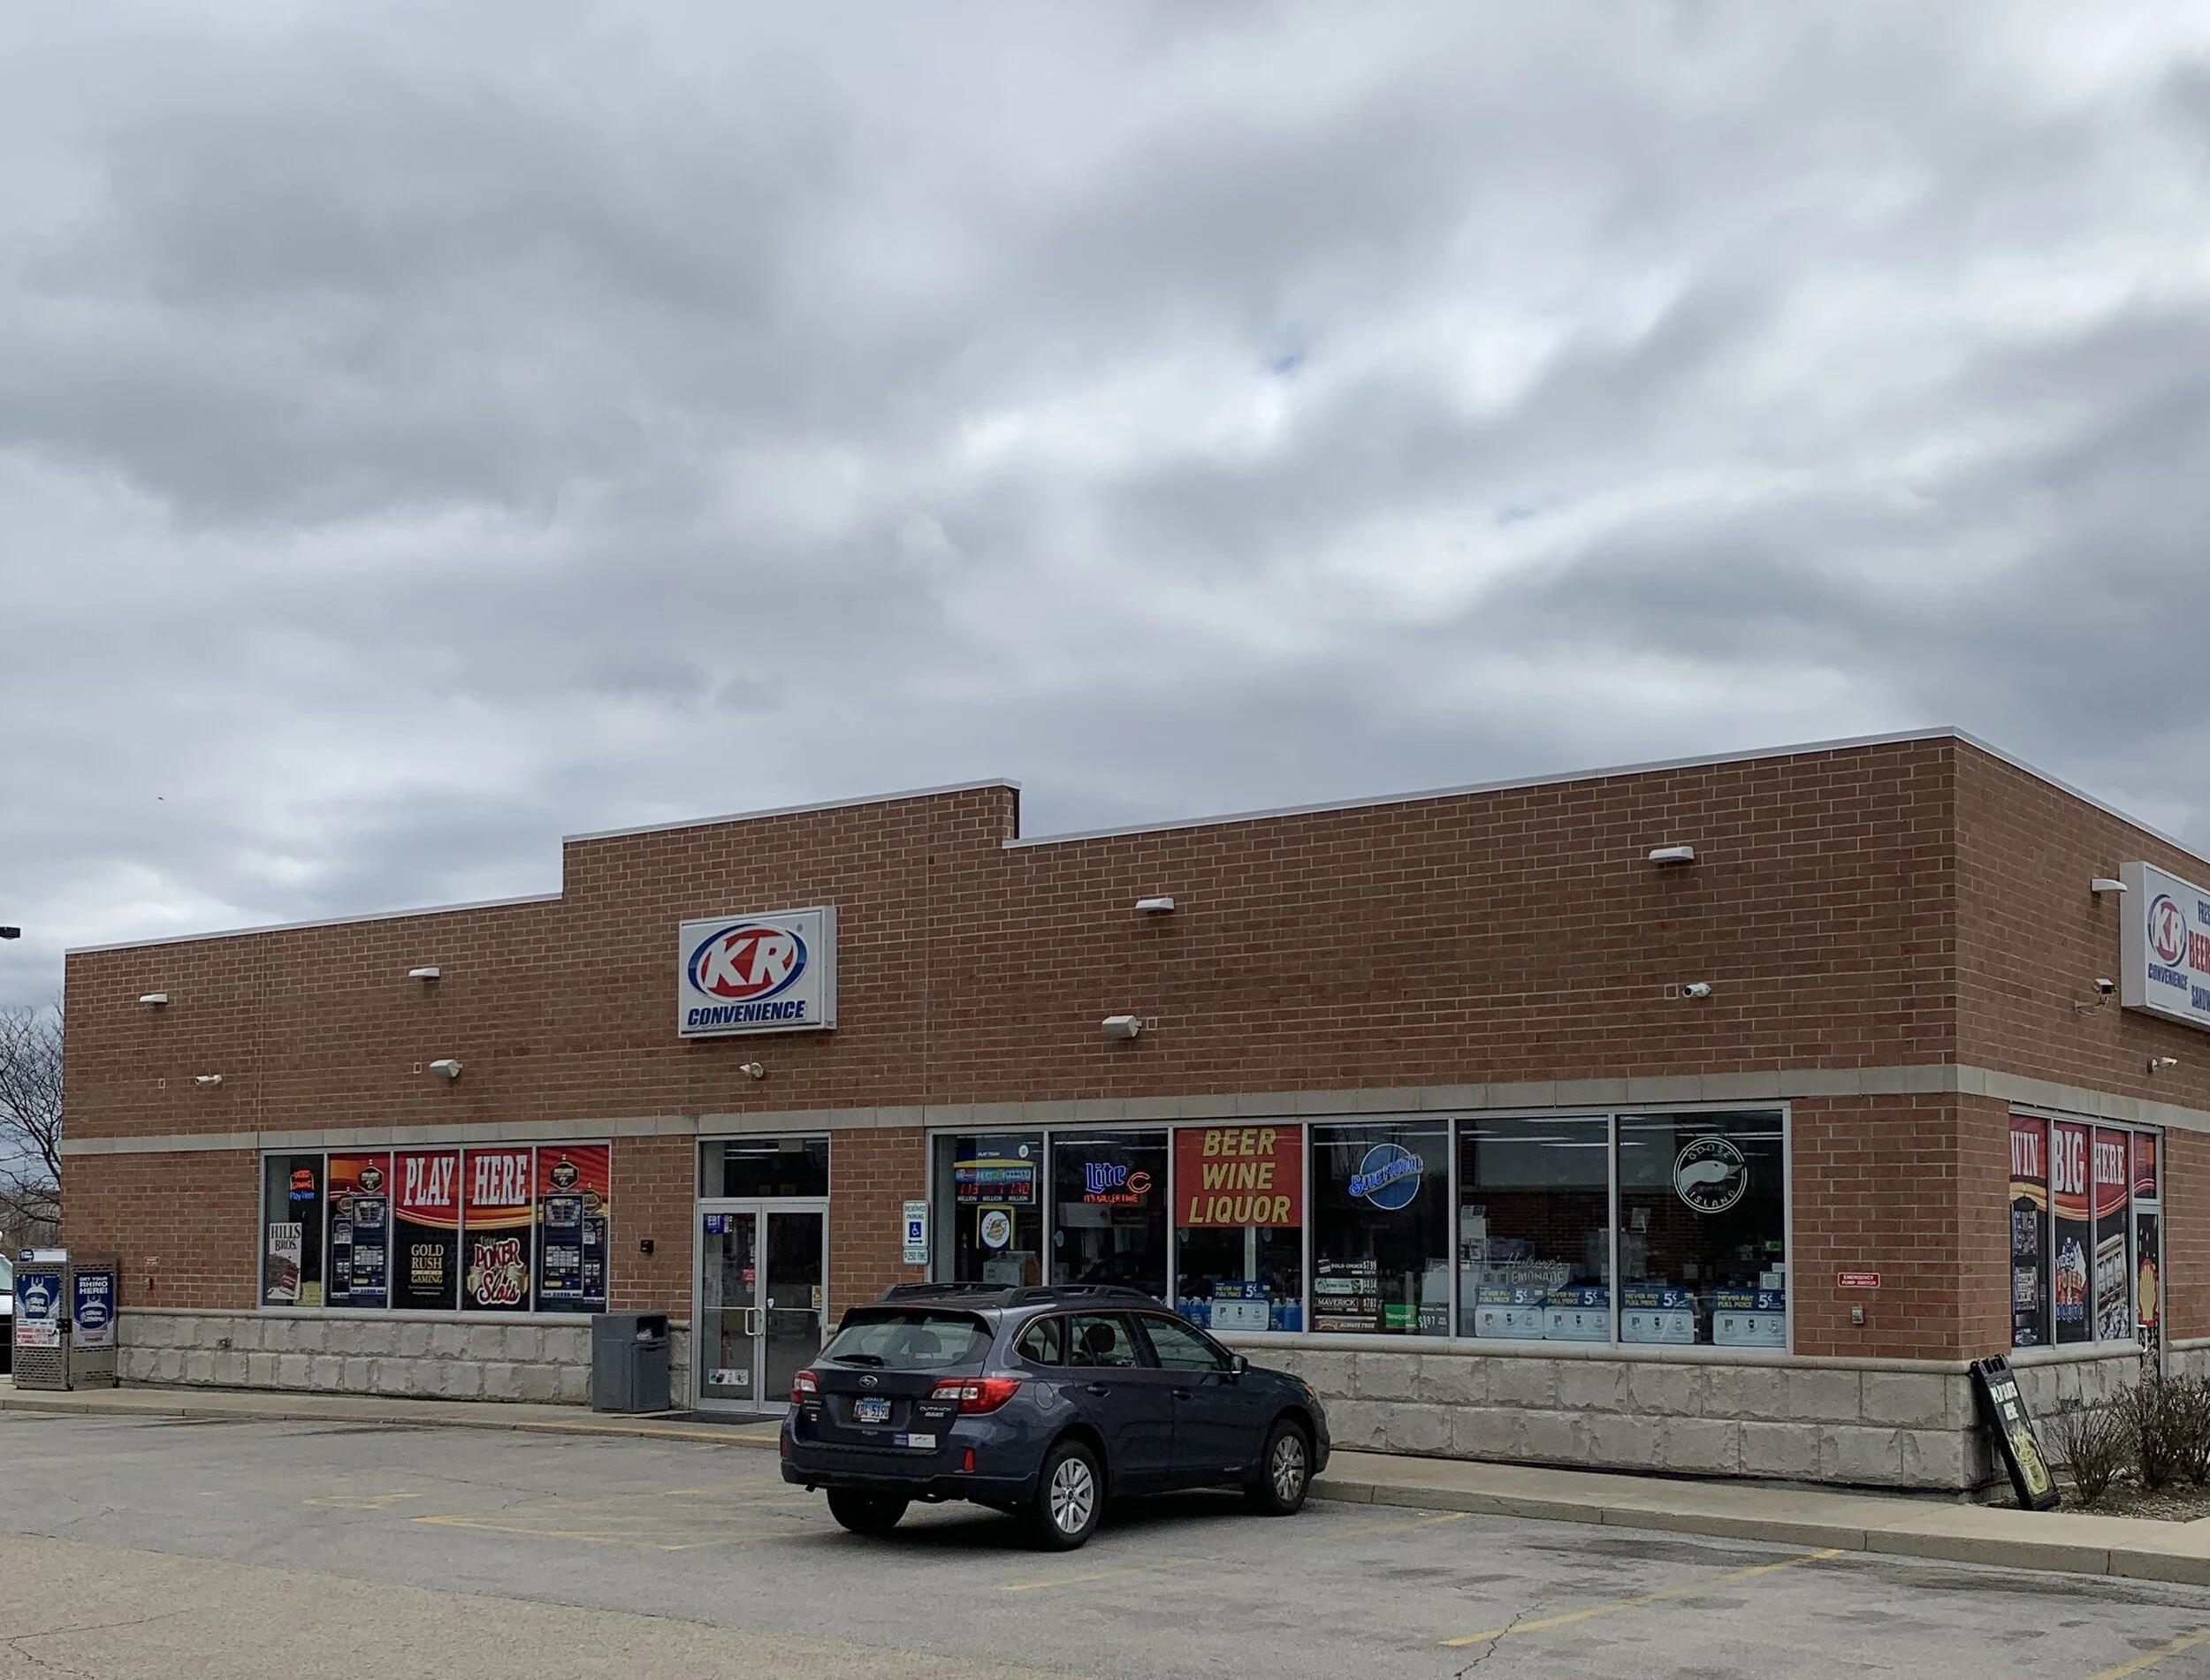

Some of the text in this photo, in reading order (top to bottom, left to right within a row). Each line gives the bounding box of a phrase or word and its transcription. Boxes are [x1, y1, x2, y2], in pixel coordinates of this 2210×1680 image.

[2153, 908, 2183, 954] KR
[705, 935, 793, 988] KR
[2148, 962, 2188, 991] CONVENIENCE
[687, 1000, 806, 1026] CONVENIENCE
[1202, 1129, 1276, 1157] BEER
[1688, 1144, 1733, 1160] GOOSE
[2010, 1131, 2039, 1176] WIN
[2054, 1129, 2084, 1194] BIG
[2095, 1142, 2124, 1185] HERE
[403, 1155, 528, 1206] PLAY HERE
[1085, 1162, 1126, 1194] Lite
[1202, 1162, 1276, 1190] WINE
[1097, 1194, 1121, 1203] MILLER
[1189, 1196, 1291, 1224] LIQUOR
[1689, 1190, 1735, 1207] ISLAND
[271, 1224, 301, 1239] HILLS
[707, 1215, 720, 1226] EBT
[411, 1243, 444, 1256] GOLD
[411, 1257, 442, 1269] RUSH
[475, 1238, 523, 1270] POKER
[411, 1274, 443, 1283] GAMING
[477, 1270, 521, 1304] Slots
